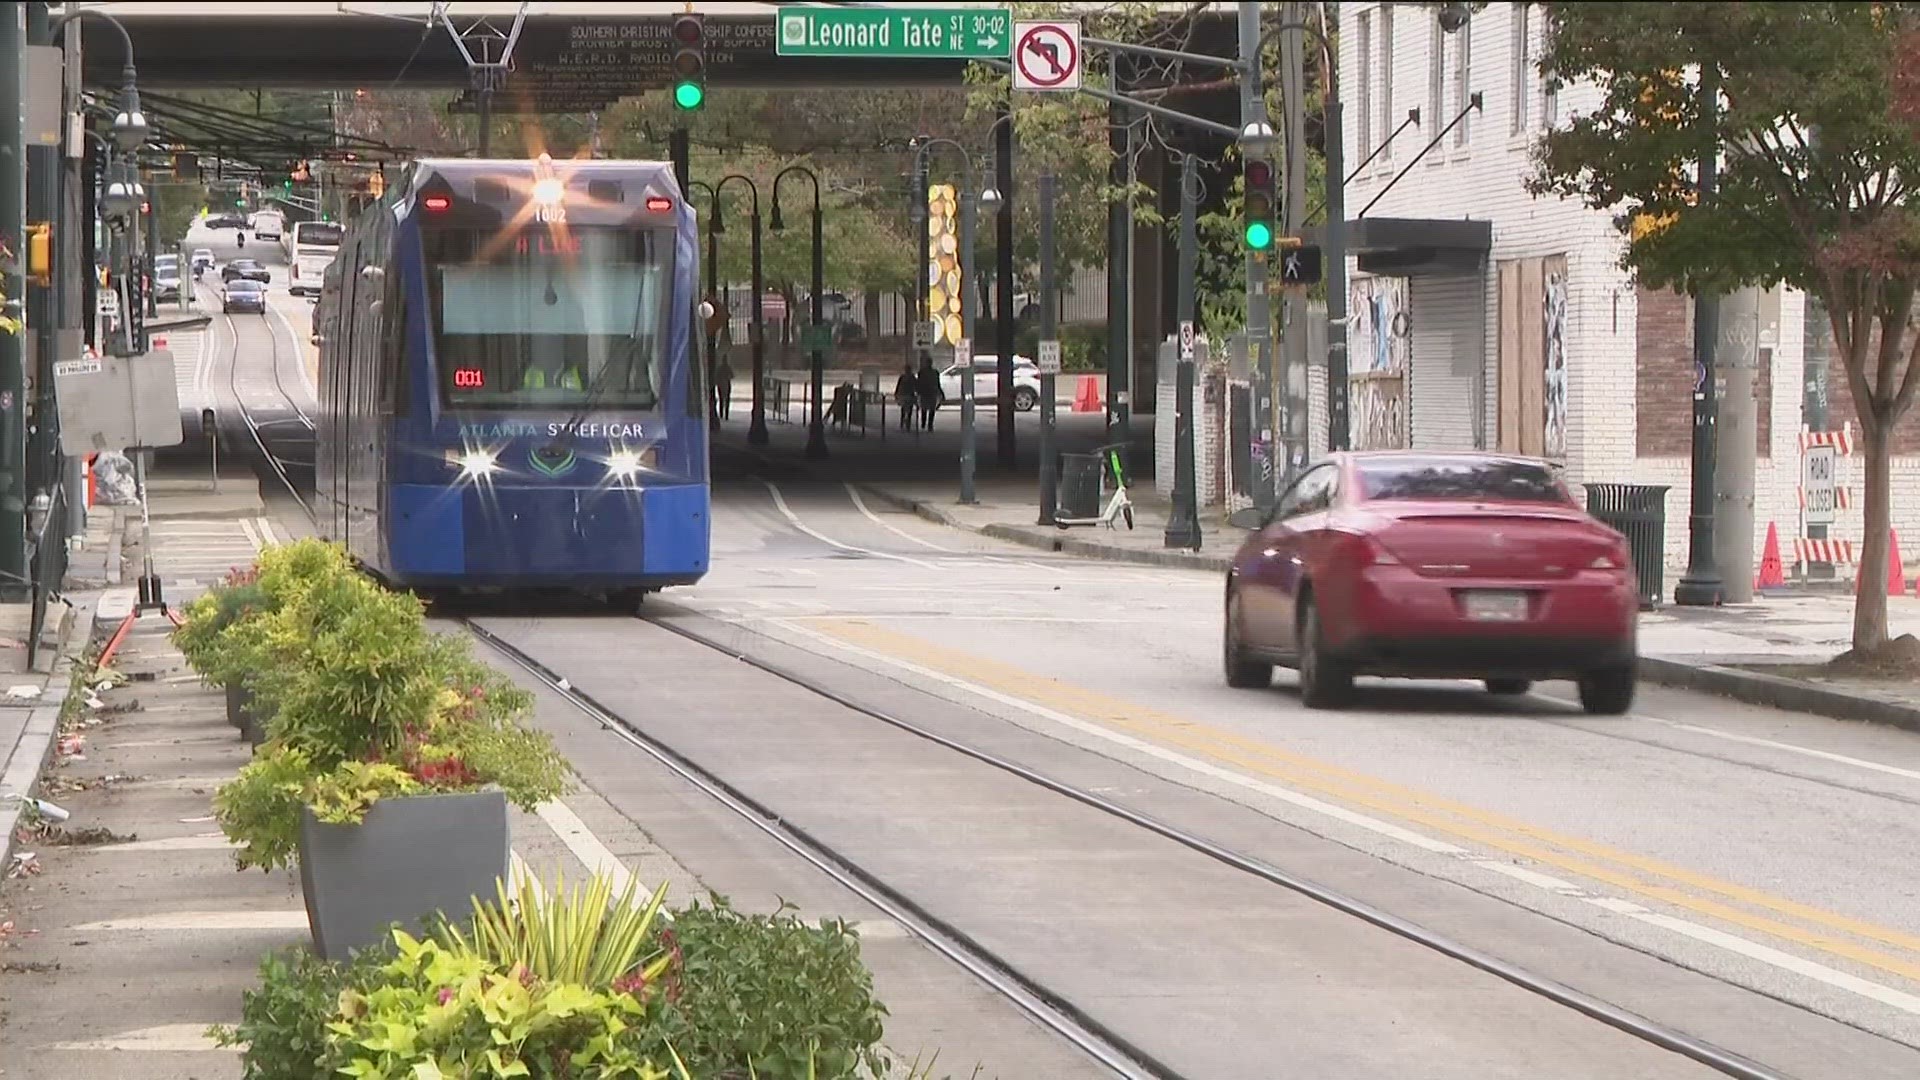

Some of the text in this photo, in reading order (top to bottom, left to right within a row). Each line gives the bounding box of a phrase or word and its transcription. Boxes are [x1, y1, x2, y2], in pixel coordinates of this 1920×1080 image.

[571, 26, 617, 39] SOUTHERN
[620, 26, 671, 39] CHRISTIAN
[809, 15, 1005, 47] Leonard Tate ST 30-02
[950, 34, 964, 50] NE
[559, 53, 671, 64] W.E.R.D. RADIO
[535, 207, 567, 223] 1002
[455, 370, 483, 386] 001
[458, 424, 537, 437] ATLANTA
[1810, 456, 1829, 480] ROAD
[1807, 489, 1832, 512] CLOSED
